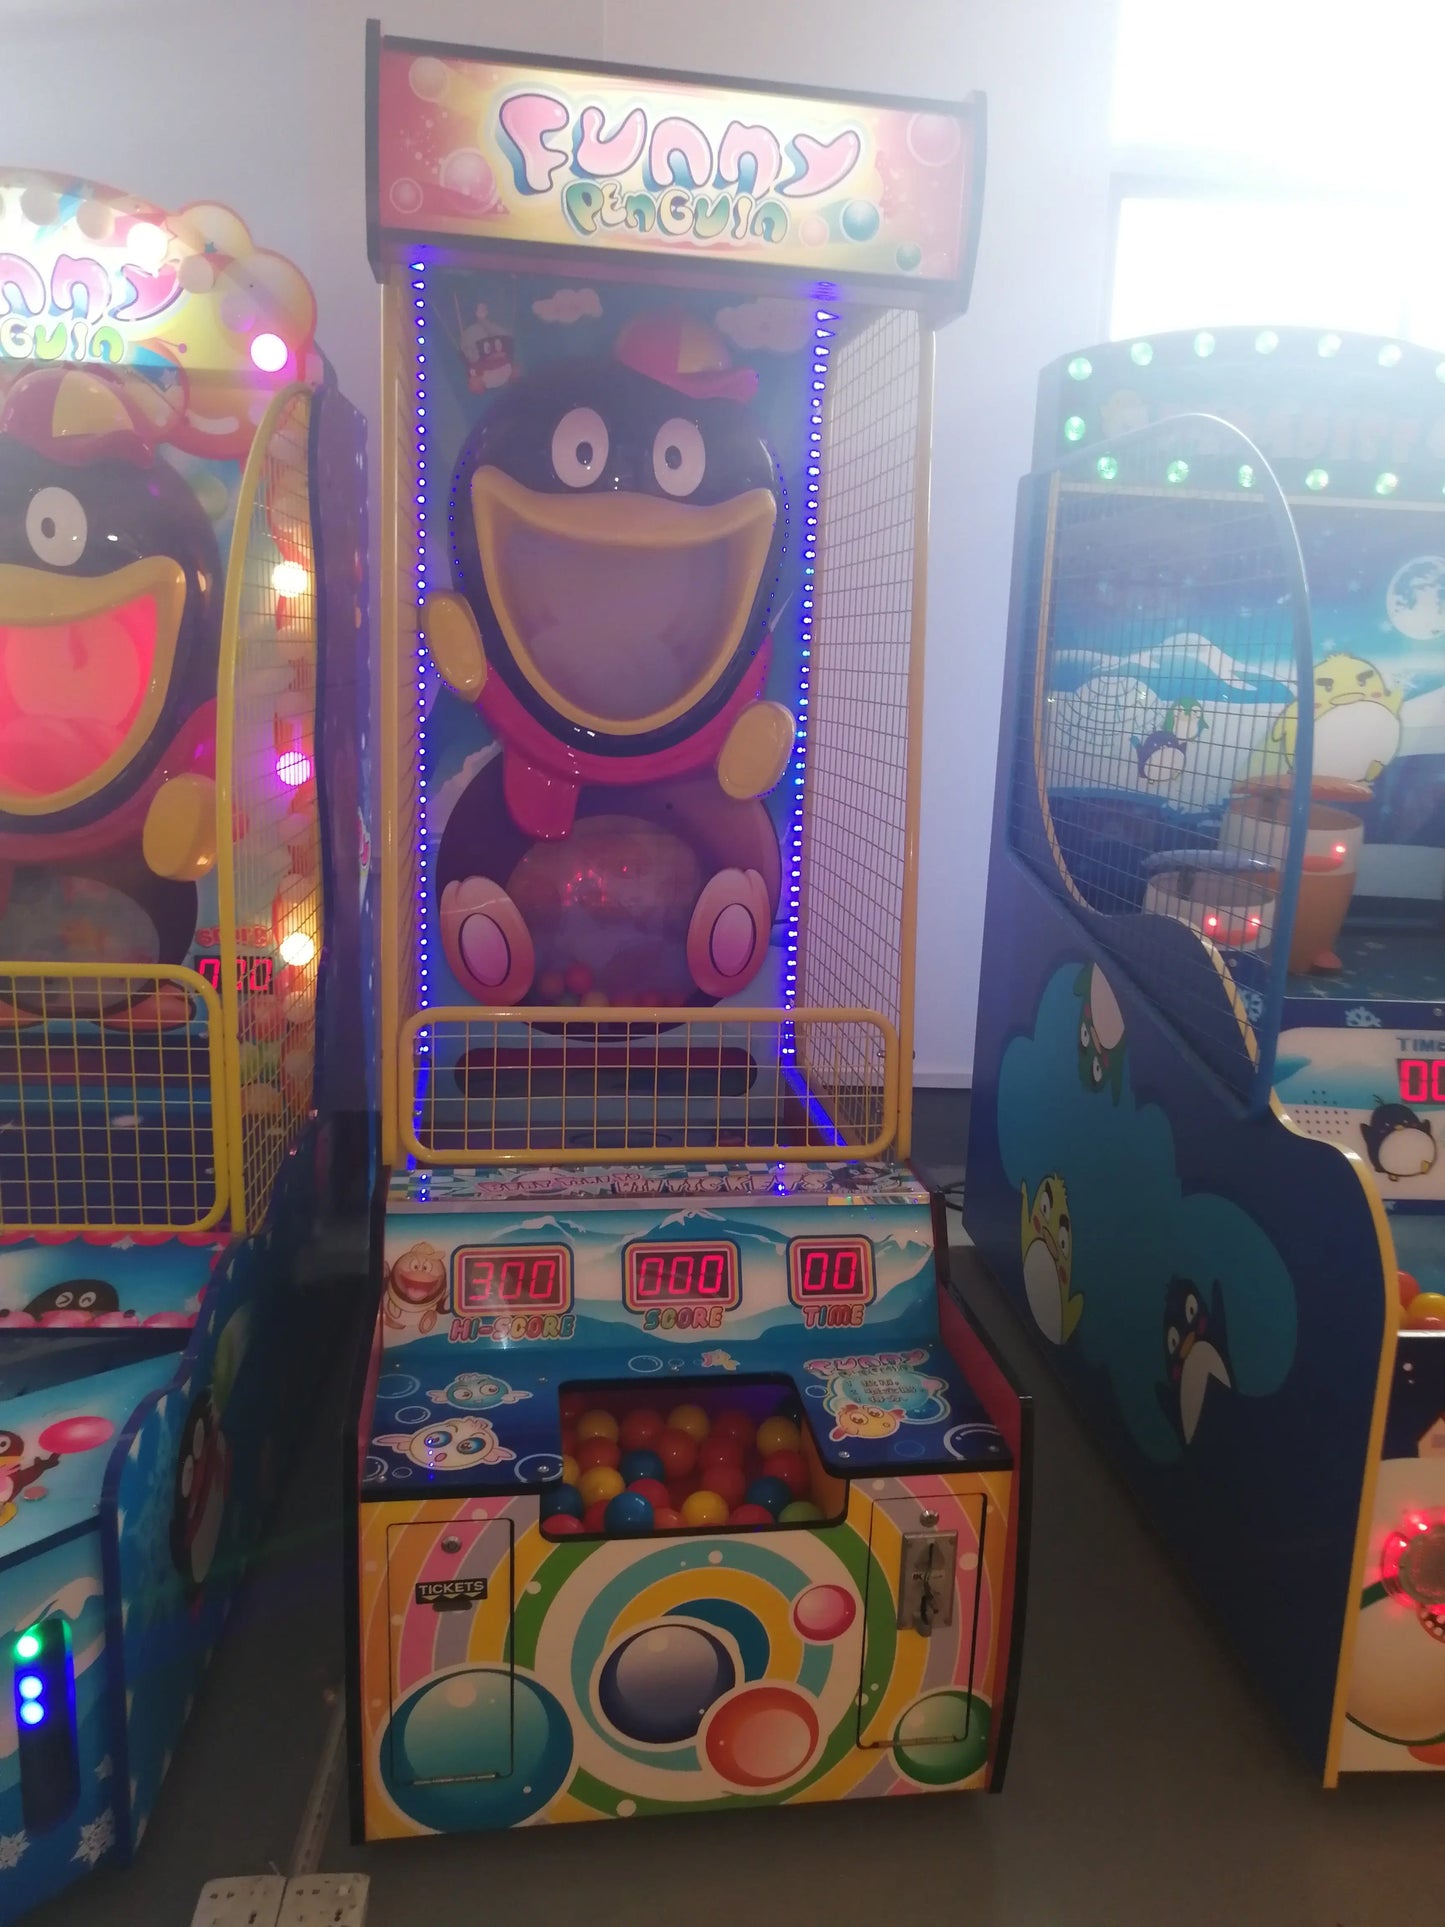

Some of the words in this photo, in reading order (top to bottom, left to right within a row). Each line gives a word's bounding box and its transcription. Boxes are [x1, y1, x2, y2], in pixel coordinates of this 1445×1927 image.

[469, 1260, 556, 1300] 300
[638, 1255, 724, 1296] 000
[804, 1252, 857, 1291] 00
[449, 1314, 577, 1342] HI-SCORE
[643, 1305, 724, 1331] SCORE
[803, 1304, 865, 1328] TIME
[418, 1581, 485, 1595] TICKETS
